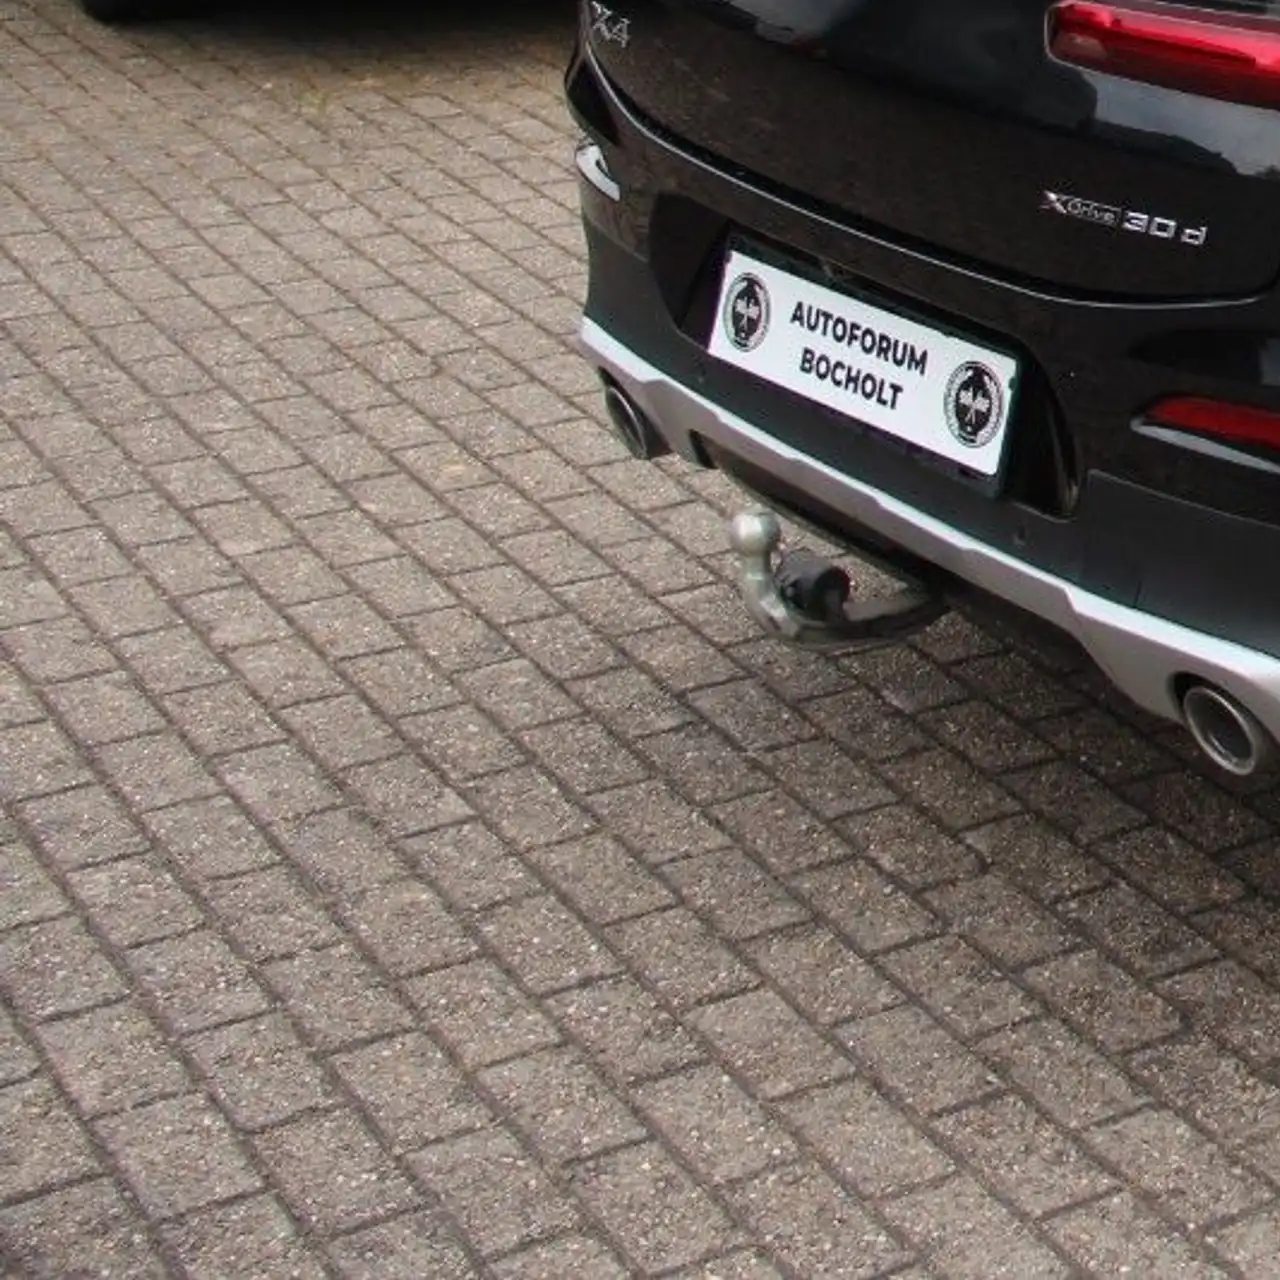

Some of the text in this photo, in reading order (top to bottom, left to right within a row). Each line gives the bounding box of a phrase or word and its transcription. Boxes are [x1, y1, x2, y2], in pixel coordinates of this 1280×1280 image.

[591, 1, 632, 49] X4
[789, 300, 929, 377] AUTOFORUM
[799, 346, 905, 411] BOCHOLT
